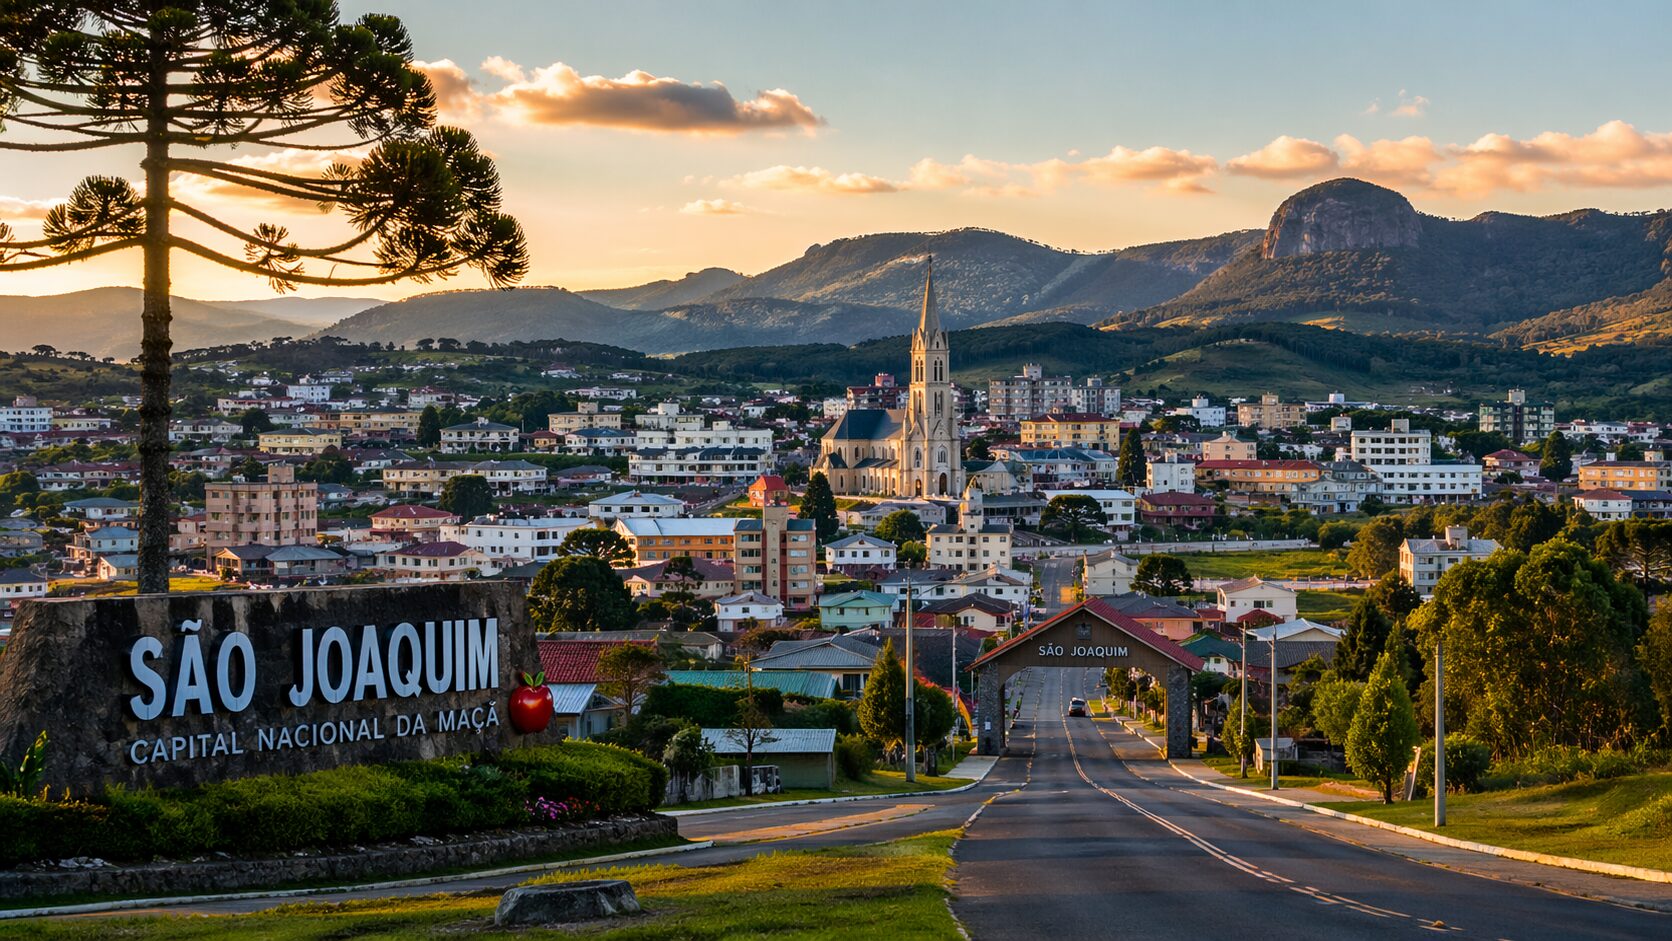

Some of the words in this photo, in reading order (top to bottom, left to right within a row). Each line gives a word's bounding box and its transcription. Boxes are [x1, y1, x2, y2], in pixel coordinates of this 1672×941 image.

[130, 619, 257, 721] SÃO
[288, 618, 499, 707] JOAQUIM
[1038, 642, 1064, 656] SÃO
[1070, 646, 1128, 658] JOAQUIM
[130, 731, 244, 765] CAPITAL
[258, 718, 385, 751] NACIONAL
[397, 714, 427, 737] DA
